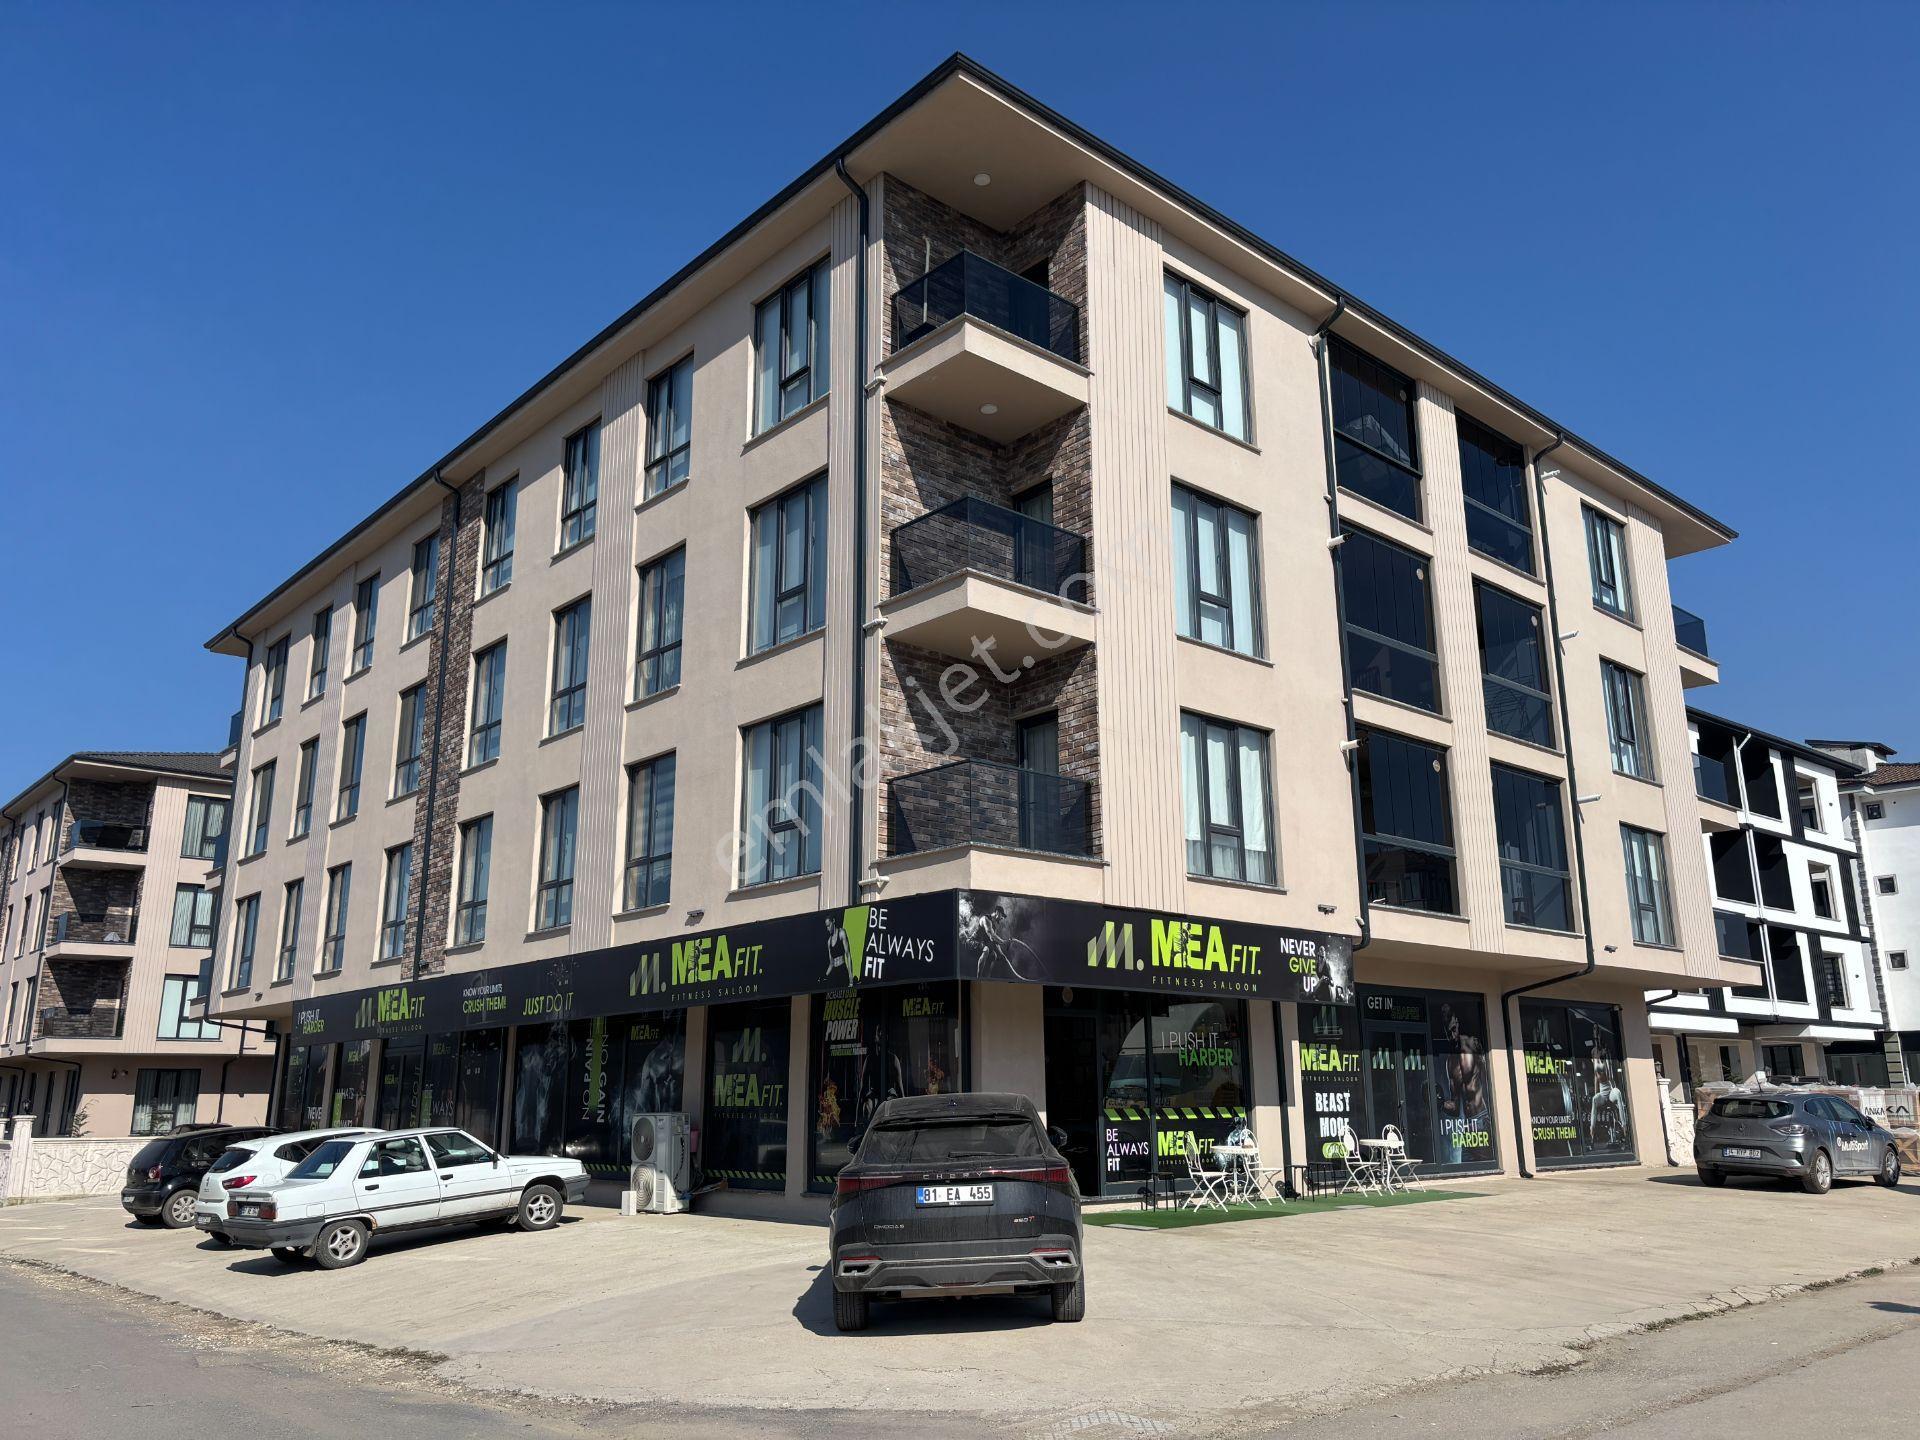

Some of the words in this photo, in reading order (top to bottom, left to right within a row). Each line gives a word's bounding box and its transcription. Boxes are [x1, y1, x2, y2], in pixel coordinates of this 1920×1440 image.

[869, 907, 888, 930] BE
[866, 932, 935, 963] ALWAYS
[1280, 937, 1316, 957] NEVER
[864, 956, 885, 979] FIT
[1289, 956, 1317, 975] GIVE
[671, 989, 711, 1002] FITNESS
[718, 984, 758, 997] SALOON
[1152, 975, 1204, 988] FITNESS
[1213, 980, 1257, 992] SALOON
[1303, 975, 1318, 993] UP
[462, 999, 484, 1014] CRUSH
[522, 996, 545, 1016] JUST
[546, 993, 563, 1013] DO
[565, 992, 574, 1011] IT
[823, 997, 861, 1022] MUSCLE
[1367, 996, 1382, 1010] GET
[1384, 996, 1393, 1010] IN
[825, 1018, 859, 1041] POWER
[601, 1034, 608, 1065] NO
[1161, 1031, 1165, 1050] I
[1169, 1031, 1205, 1050] PUSH
[1208, 1032, 1219, 1050] IT
[583, 1038, 593, 1083] PAIN
[1178, 1047, 1234, 1067] HARDER
[581, 1089, 590, 1120] NO
[596, 1071, 607, 1123] GAIN
[1315, 1092, 1351, 1112] BEAST
[1106, 1128, 1119, 1142] BE
[1319, 1116, 1350, 1138] MODE
[1440, 1119, 1444, 1135] I
[1445, 1118, 1469, 1135] PUSH
[1471, 1118, 1478, 1133] IT
[1532, 1126, 1556, 1141] CRUSH
[1106, 1141, 1149, 1157] ALWAYS
[1452, 1131, 1489, 1148] HARDER
[1841, 1140, 1868, 1152] MultiSport
[1107, 1157, 1121, 1172] FIT
[923, 1172, 983, 1180] CHERY
[924, 1188, 937, 1202] 81
[946, 1187, 961, 1201] EA
[969, 1186, 991, 1200] 455
